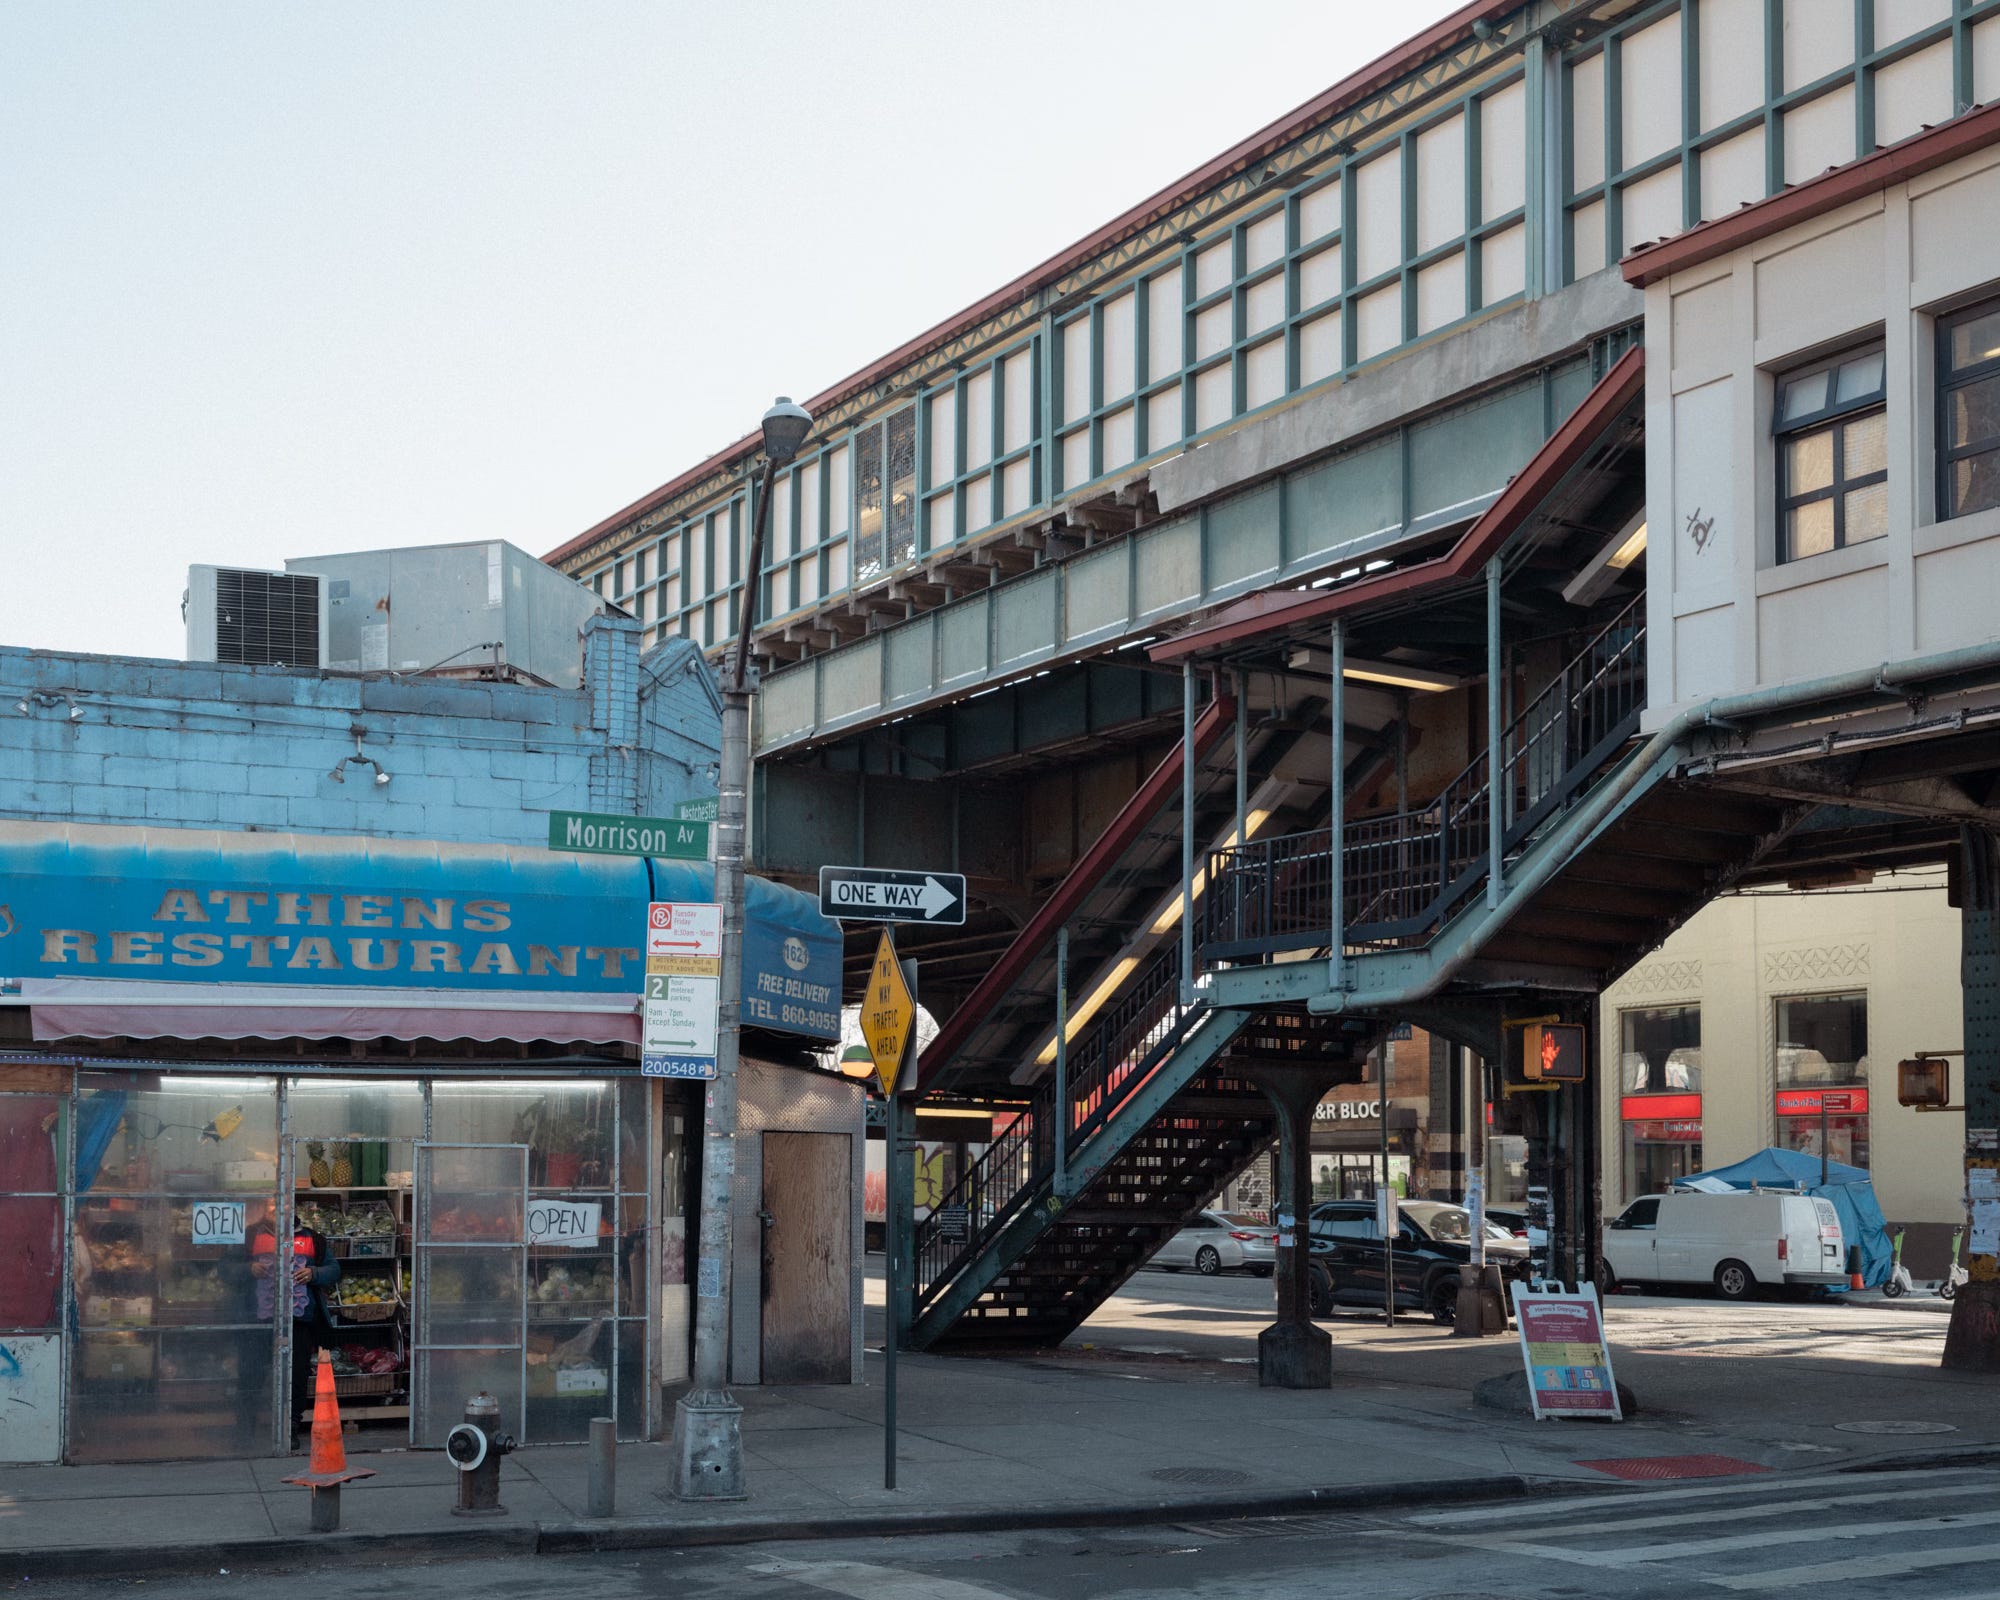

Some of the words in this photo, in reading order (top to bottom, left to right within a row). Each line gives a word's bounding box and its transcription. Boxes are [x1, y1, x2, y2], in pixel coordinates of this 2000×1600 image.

[566, 817, 666, 852] Morrison
[677, 825, 695, 844] Av
[838, 883, 877, 903] ONE
[884, 886, 923, 906] WAY
[152, 888, 512, 932] ATHENS
[40, 929, 640, 978] RESTAURANT
[784, 943, 808, 964] 1621
[879, 958, 892, 978] TWO
[651, 978, 663, 998] 2
[757, 972, 784, 995] FREE
[785, 978, 831, 1004] DELIVERY
[879, 984, 891, 1004] WAY
[648, 1008, 662, 1016] 9am
[669, 1009, 683, 1017] 7pm
[648, 1018, 670, 1028] Except
[672, 1019, 696, 1028] Sunday
[748, 996, 778, 1020] TEL.
[782, 1003, 837, 1031] 860-9055
[873, 1009, 899, 1030] TRAFFIC
[877, 1036, 897, 1056] AHEAD
[645, 1060, 696, 1076] 200548
[194, 1204, 244, 1236] OPEN
[529, 1208, 587, 1235] OPEN
